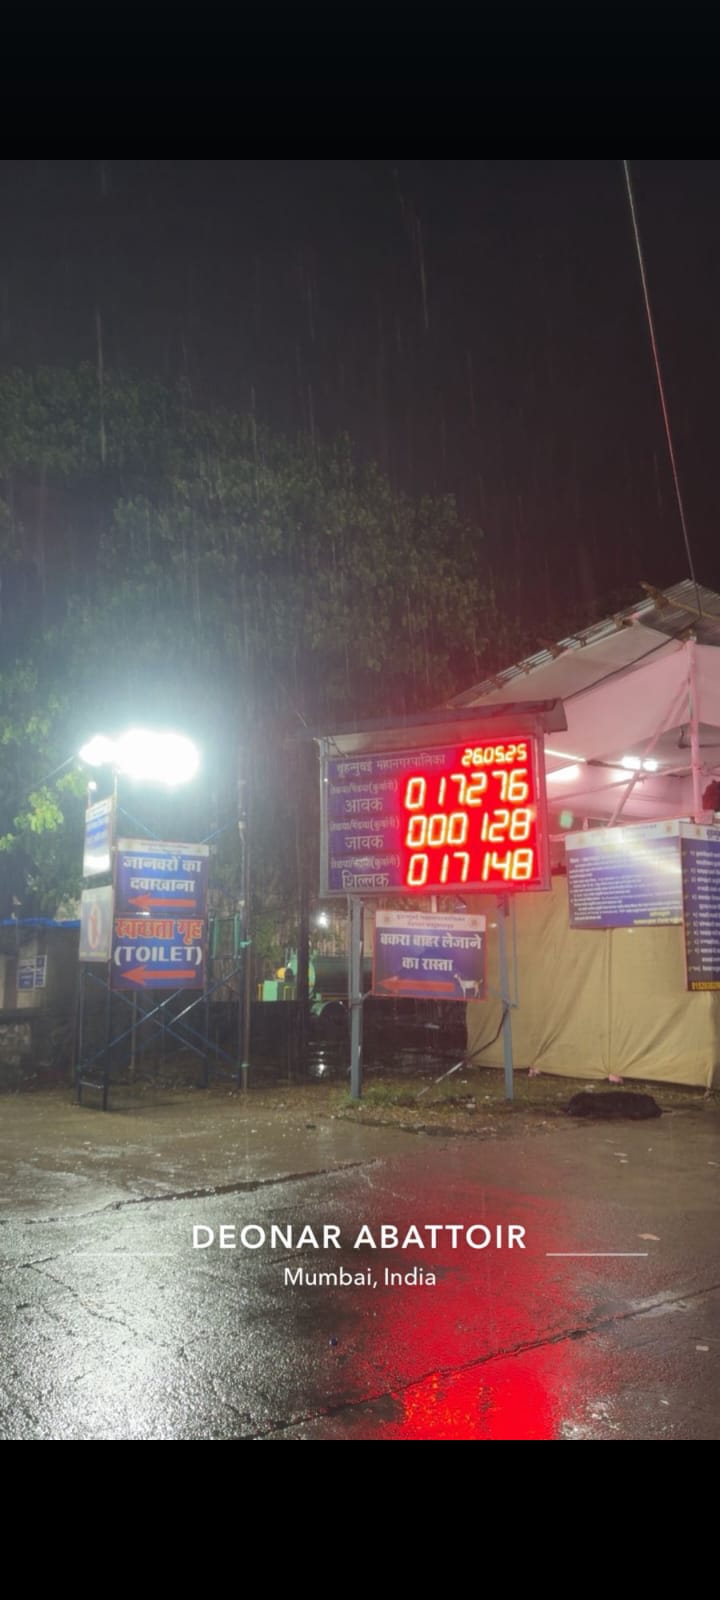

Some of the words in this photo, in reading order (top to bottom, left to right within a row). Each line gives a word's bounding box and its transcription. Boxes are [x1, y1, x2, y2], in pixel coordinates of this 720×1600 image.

[405, 769, 528, 809] 017276
[344, 797, 383, 813] आवक
[406, 808, 531, 847] 000128
[344, 835, 384, 850] जावक
[122, 856, 181, 872] जानवरों
[182, 859, 202, 873] का
[406, 848, 533, 886] 017148
[129, 877, 196, 892] दवाखाना
[342, 869, 389, 888] शिल्लक
[177, 918, 204, 945] गृह
[380, 933, 410, 946] बकरा
[412, 934, 440, 948] बाहर
[114, 946, 202, 966] (TOILET)
[402, 957, 419, 970] का
[421, 957, 454, 972] रास्ता
